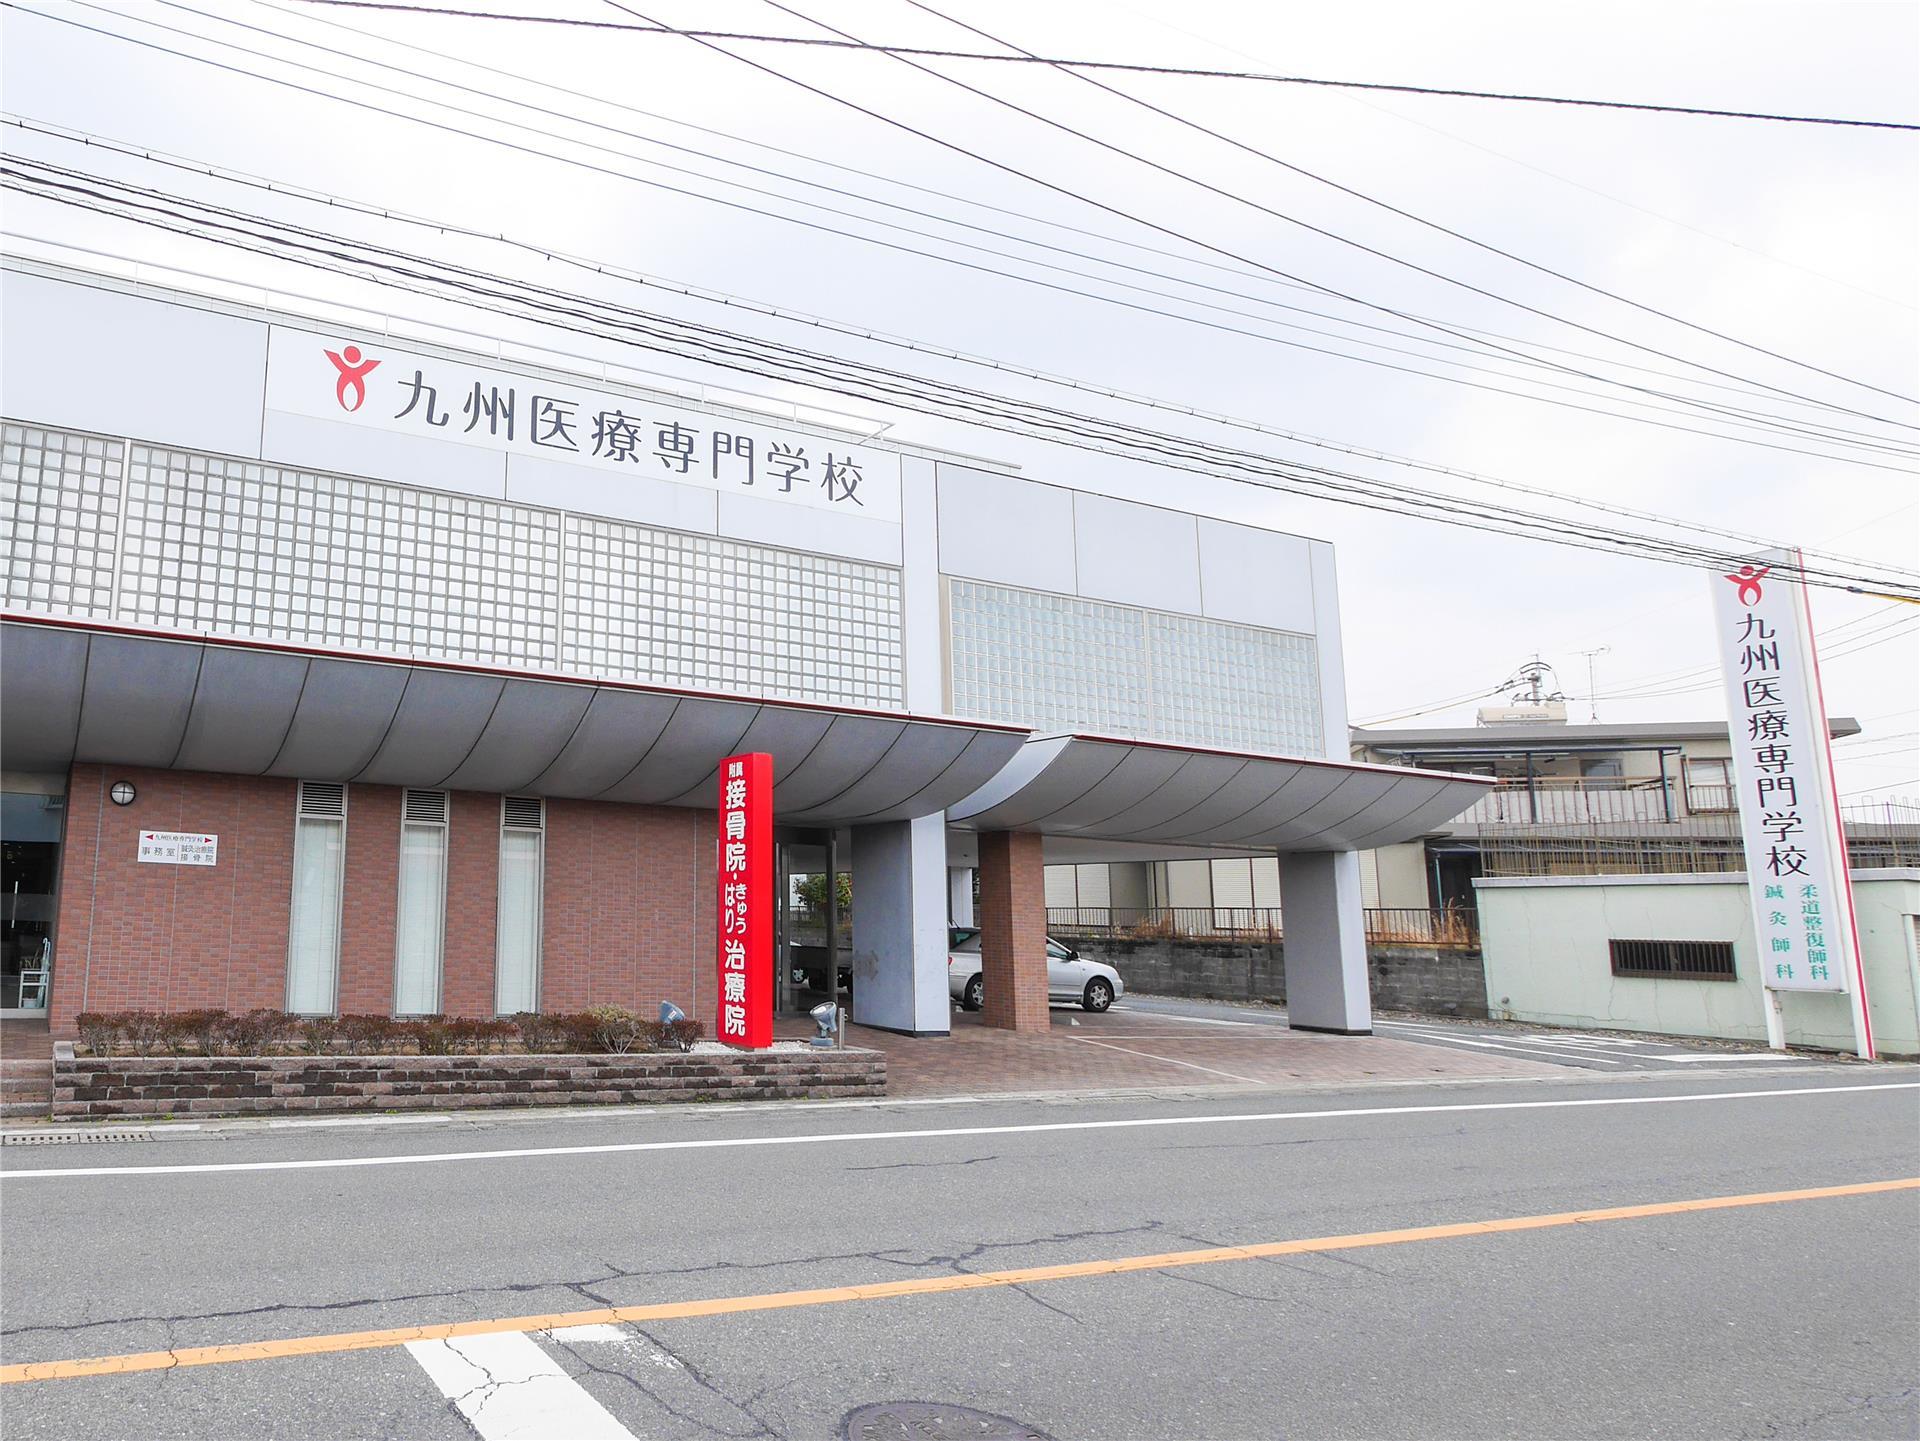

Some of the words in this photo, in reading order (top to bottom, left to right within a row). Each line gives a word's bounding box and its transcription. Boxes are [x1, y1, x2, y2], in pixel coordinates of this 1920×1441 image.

[394, 370, 865, 507] 九州医療専門学校
[1736, 613, 1810, 877] 九州医療専門学校
[1764, 884, 1795, 979] 鍼灸師科
[1799, 883, 1830, 980] 柔道整復師科
[724, 938, 746, 1037] 治療院
